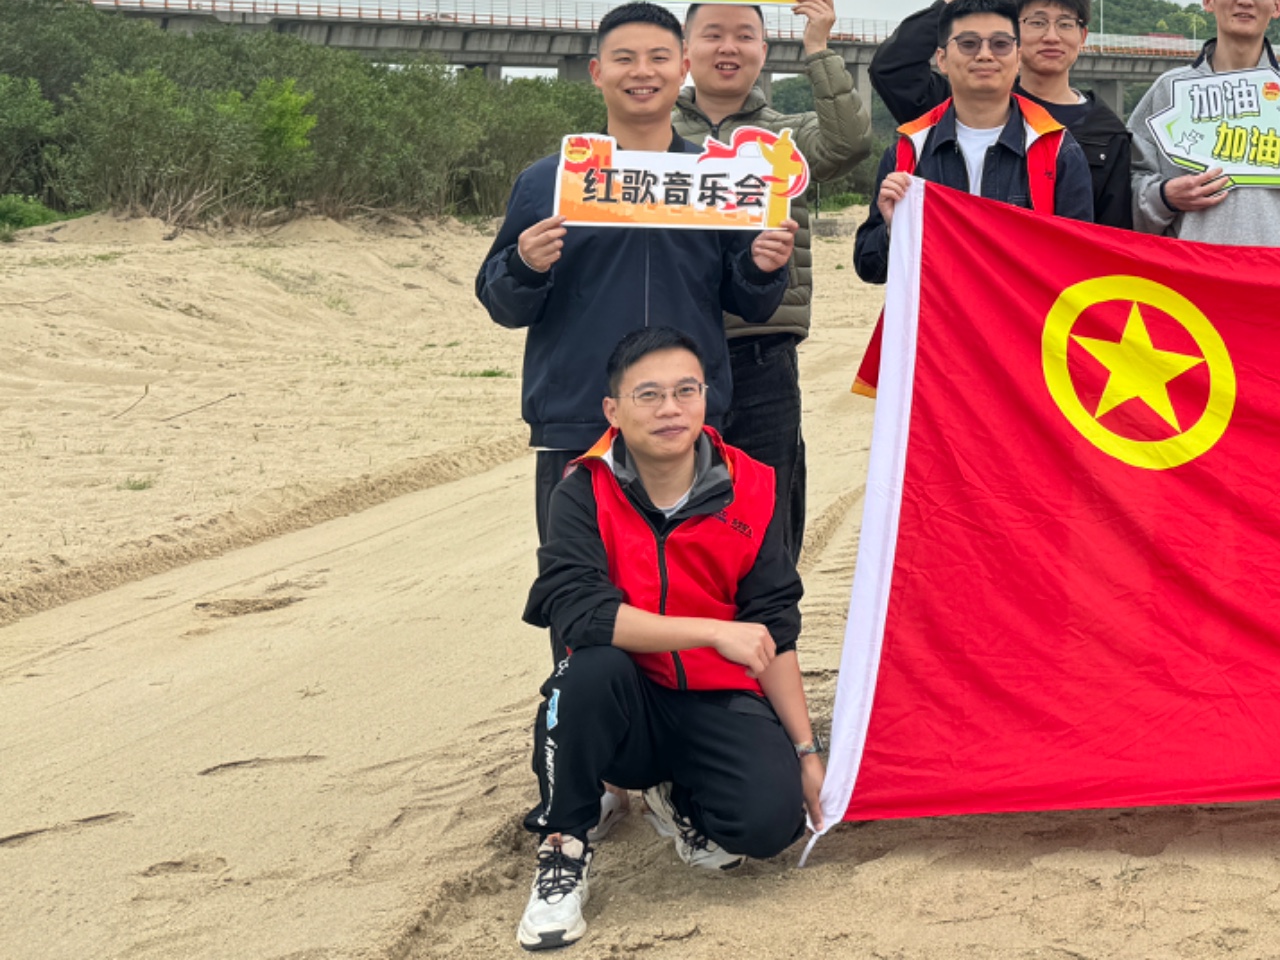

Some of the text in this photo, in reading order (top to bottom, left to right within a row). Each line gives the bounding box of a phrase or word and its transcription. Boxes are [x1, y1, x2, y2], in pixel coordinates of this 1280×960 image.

[1189, 79, 1261, 123] 加油
[582, 168, 769, 208] 红歌音乐会
